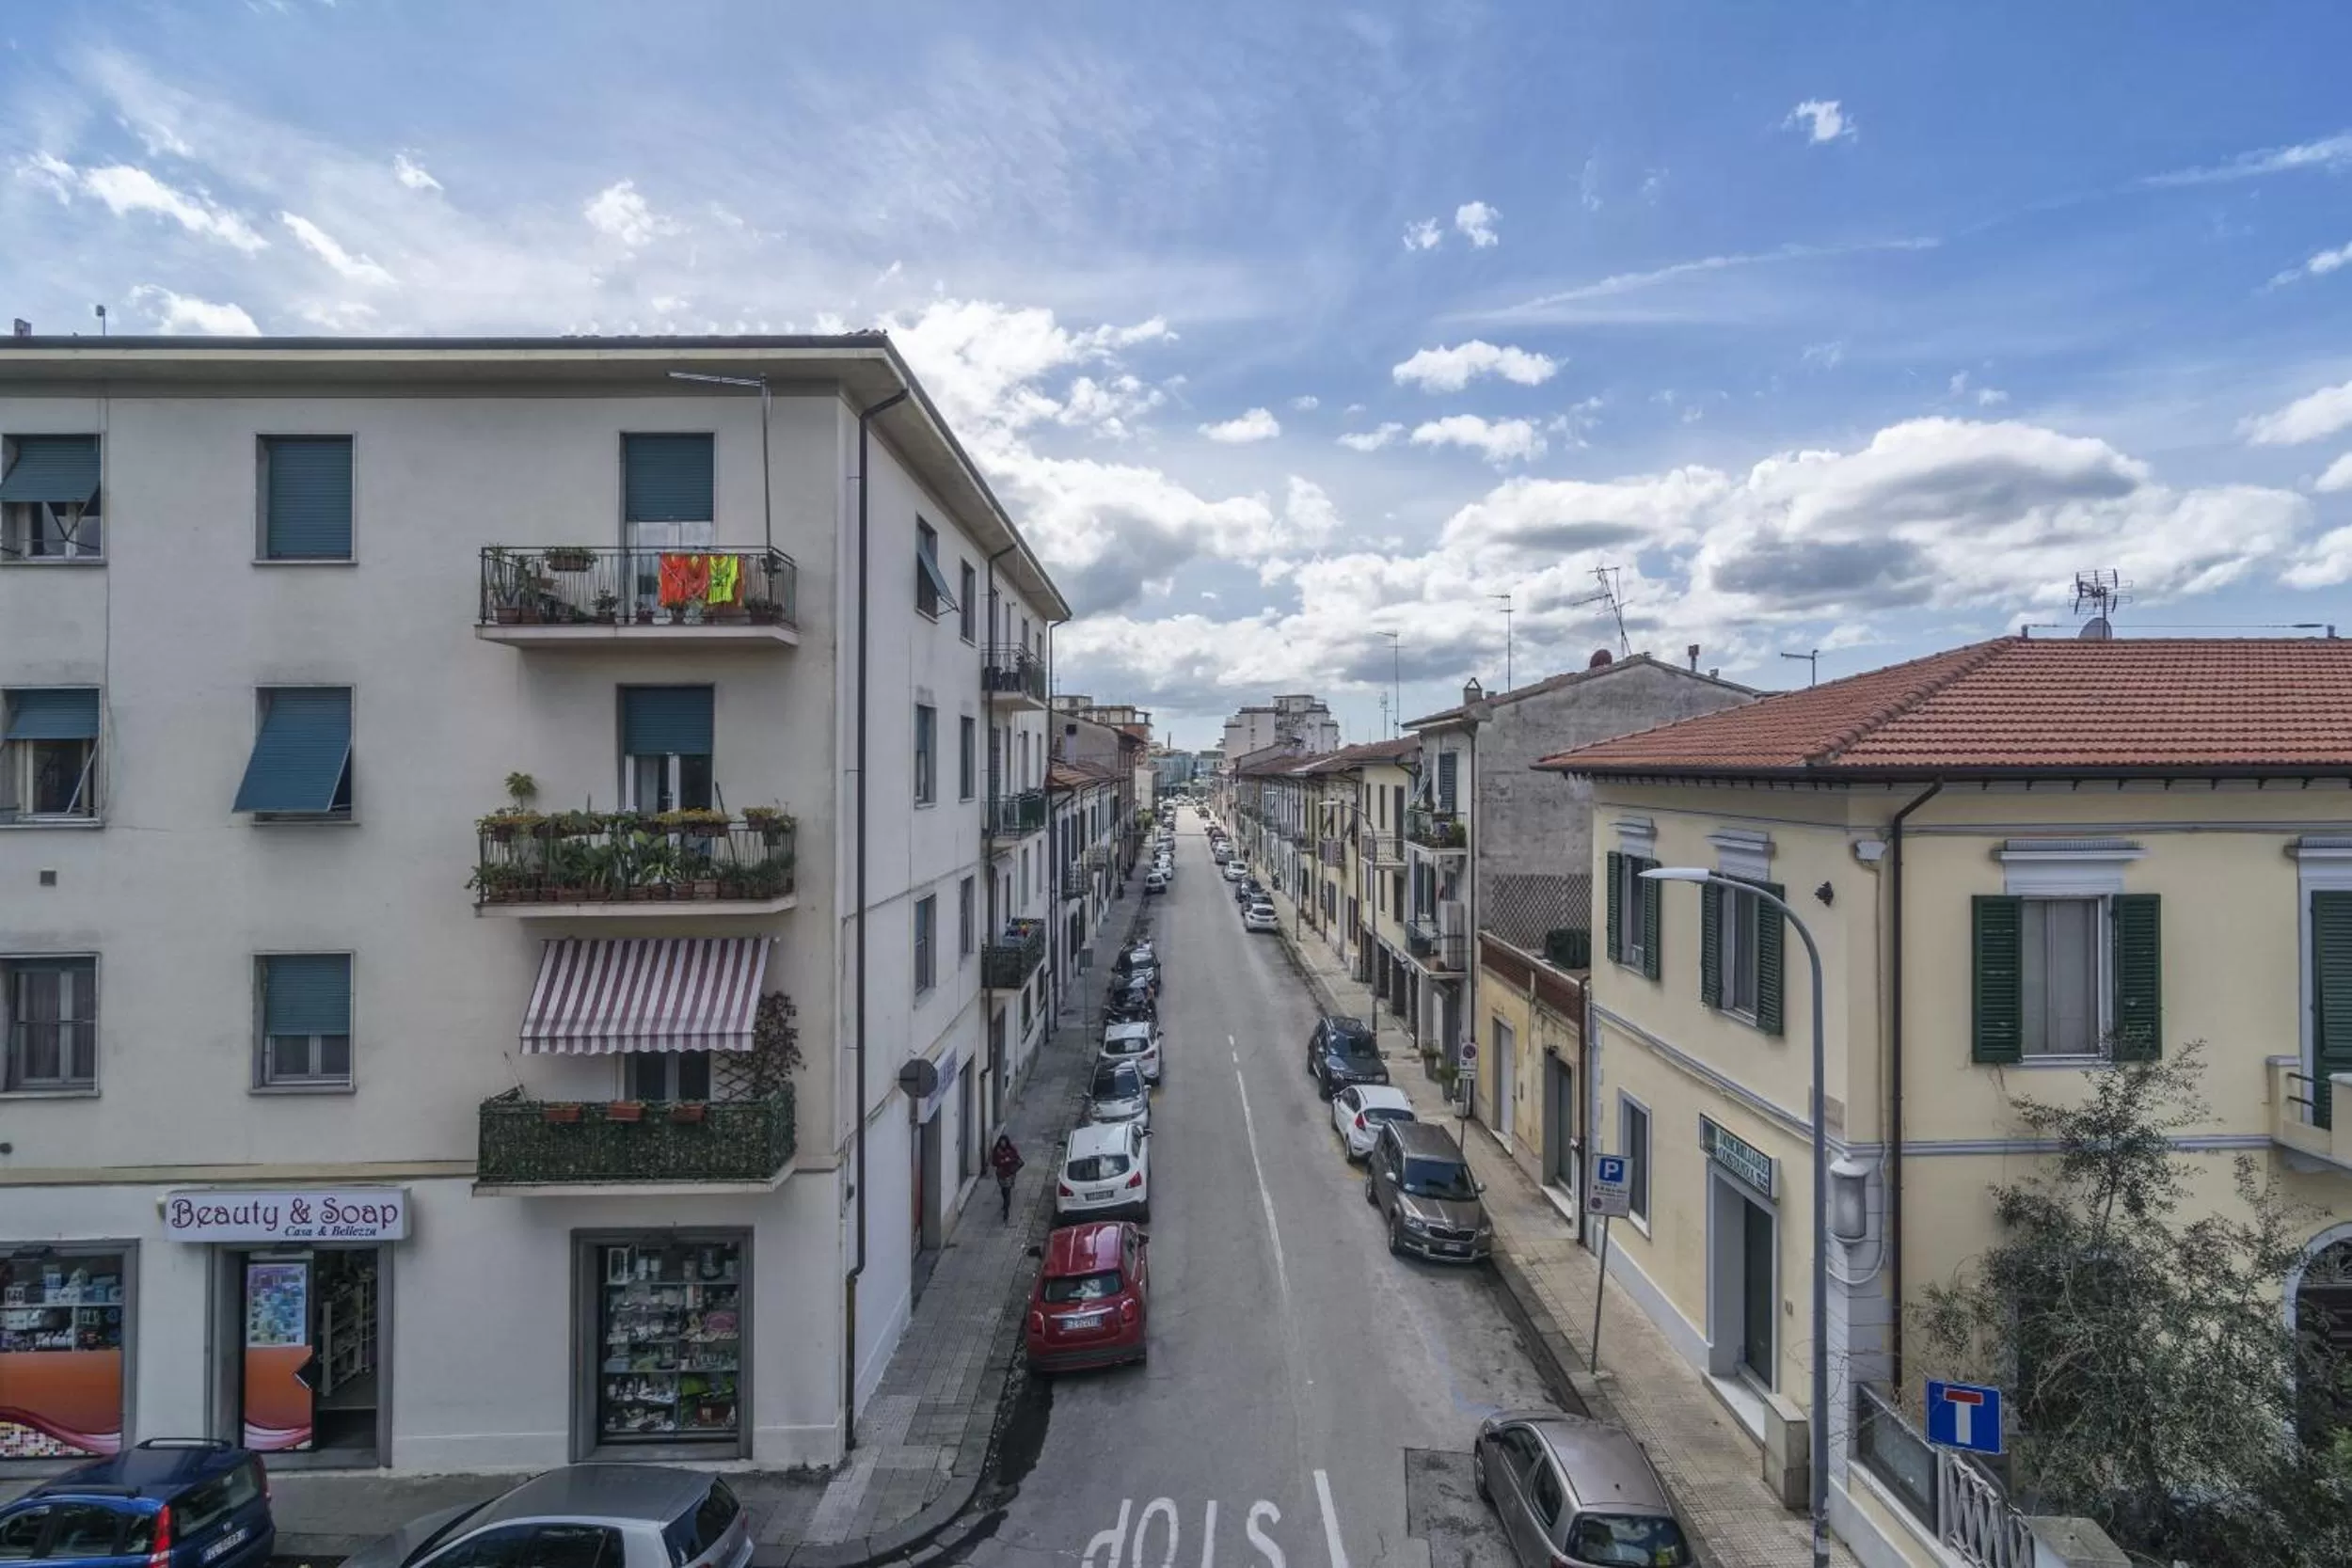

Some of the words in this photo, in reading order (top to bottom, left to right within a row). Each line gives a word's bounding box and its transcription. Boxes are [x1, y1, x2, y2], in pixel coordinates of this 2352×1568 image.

[1604, 1161, 1619, 1179] P
[171, 1198, 279, 1231] Beauty
[289, 1198, 312, 1224] &
[321, 1197, 399, 1228] Soap
[284, 1226, 312, 1237] Casa
[318, 1226, 327, 1237] &
[331, 1225, 377, 1237] Bellezza
